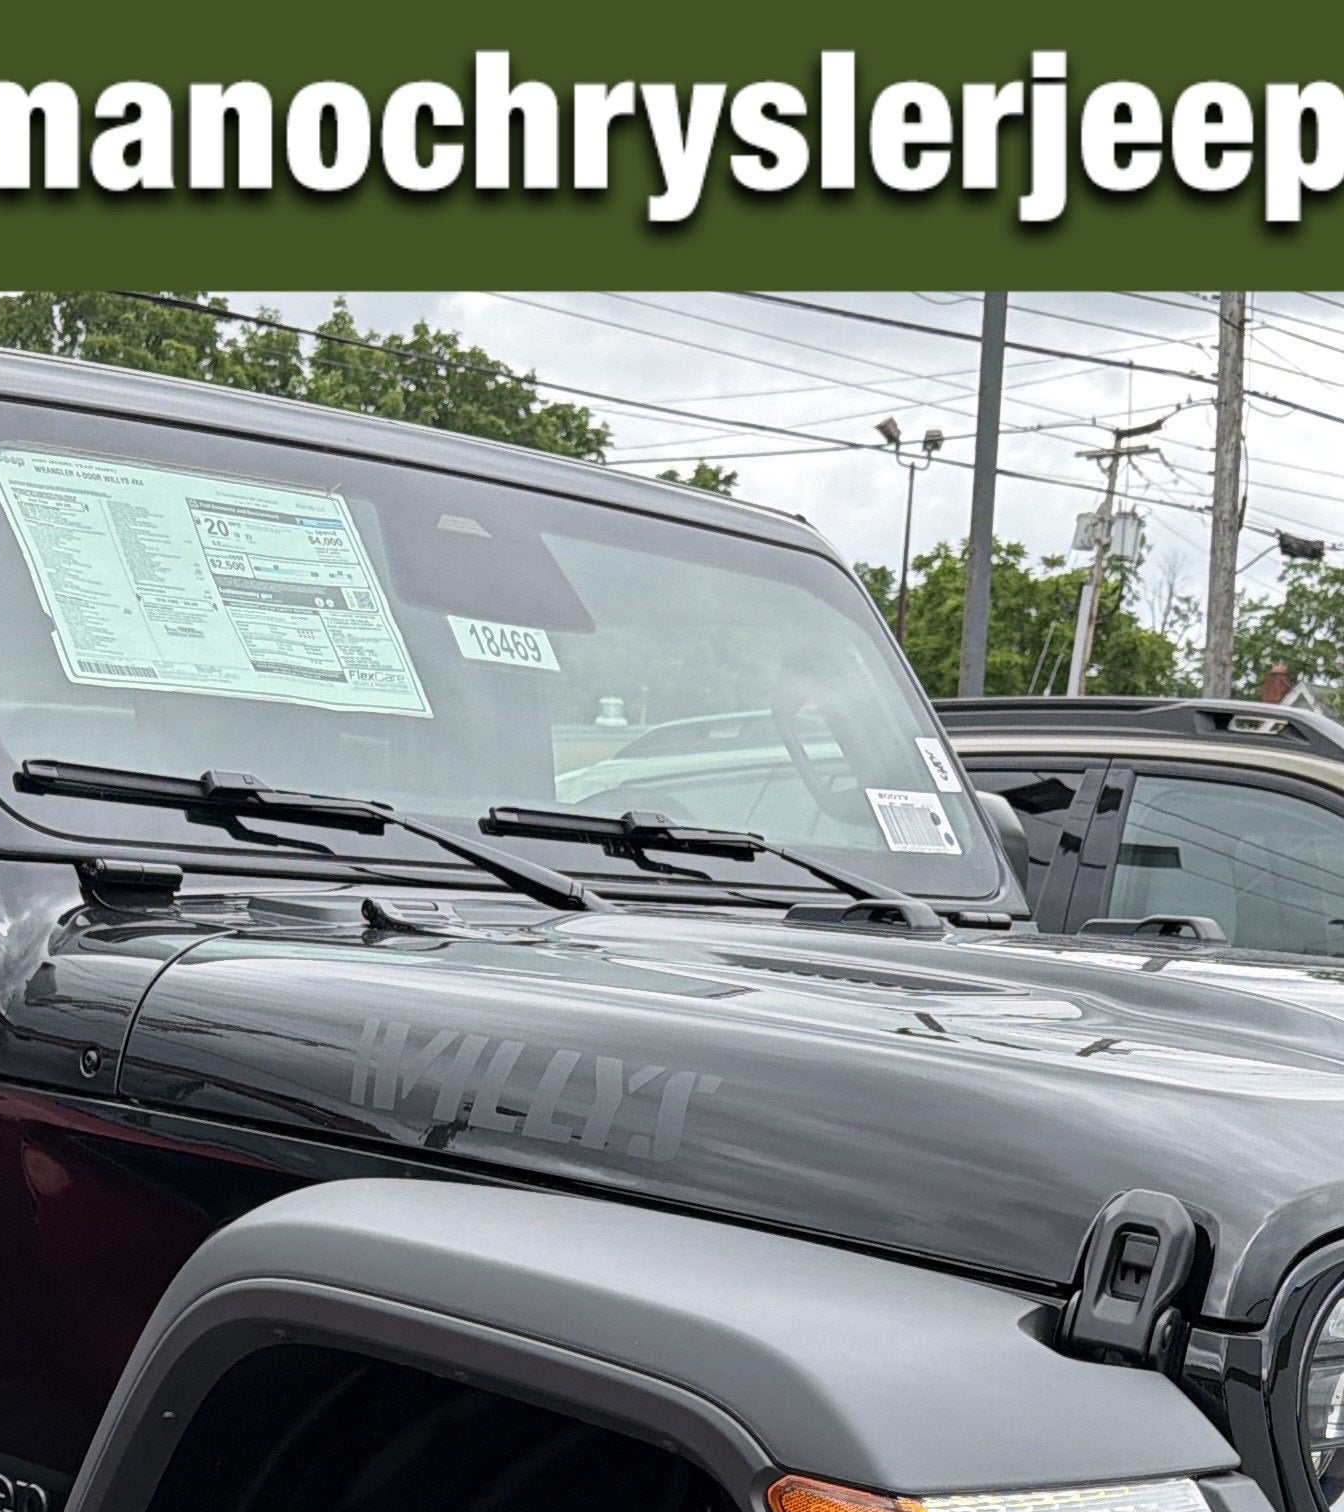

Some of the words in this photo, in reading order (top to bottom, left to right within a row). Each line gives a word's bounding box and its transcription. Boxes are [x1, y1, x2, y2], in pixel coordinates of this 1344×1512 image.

[204, 517, 230, 537] 20
[307, 535, 345, 547] $4,000
[209, 558, 246, 571] $2,500
[469, 623, 542, 662] 18469
[348, 669, 405, 683] FlexCare
[350, 1016, 724, 1163] WILLYS
